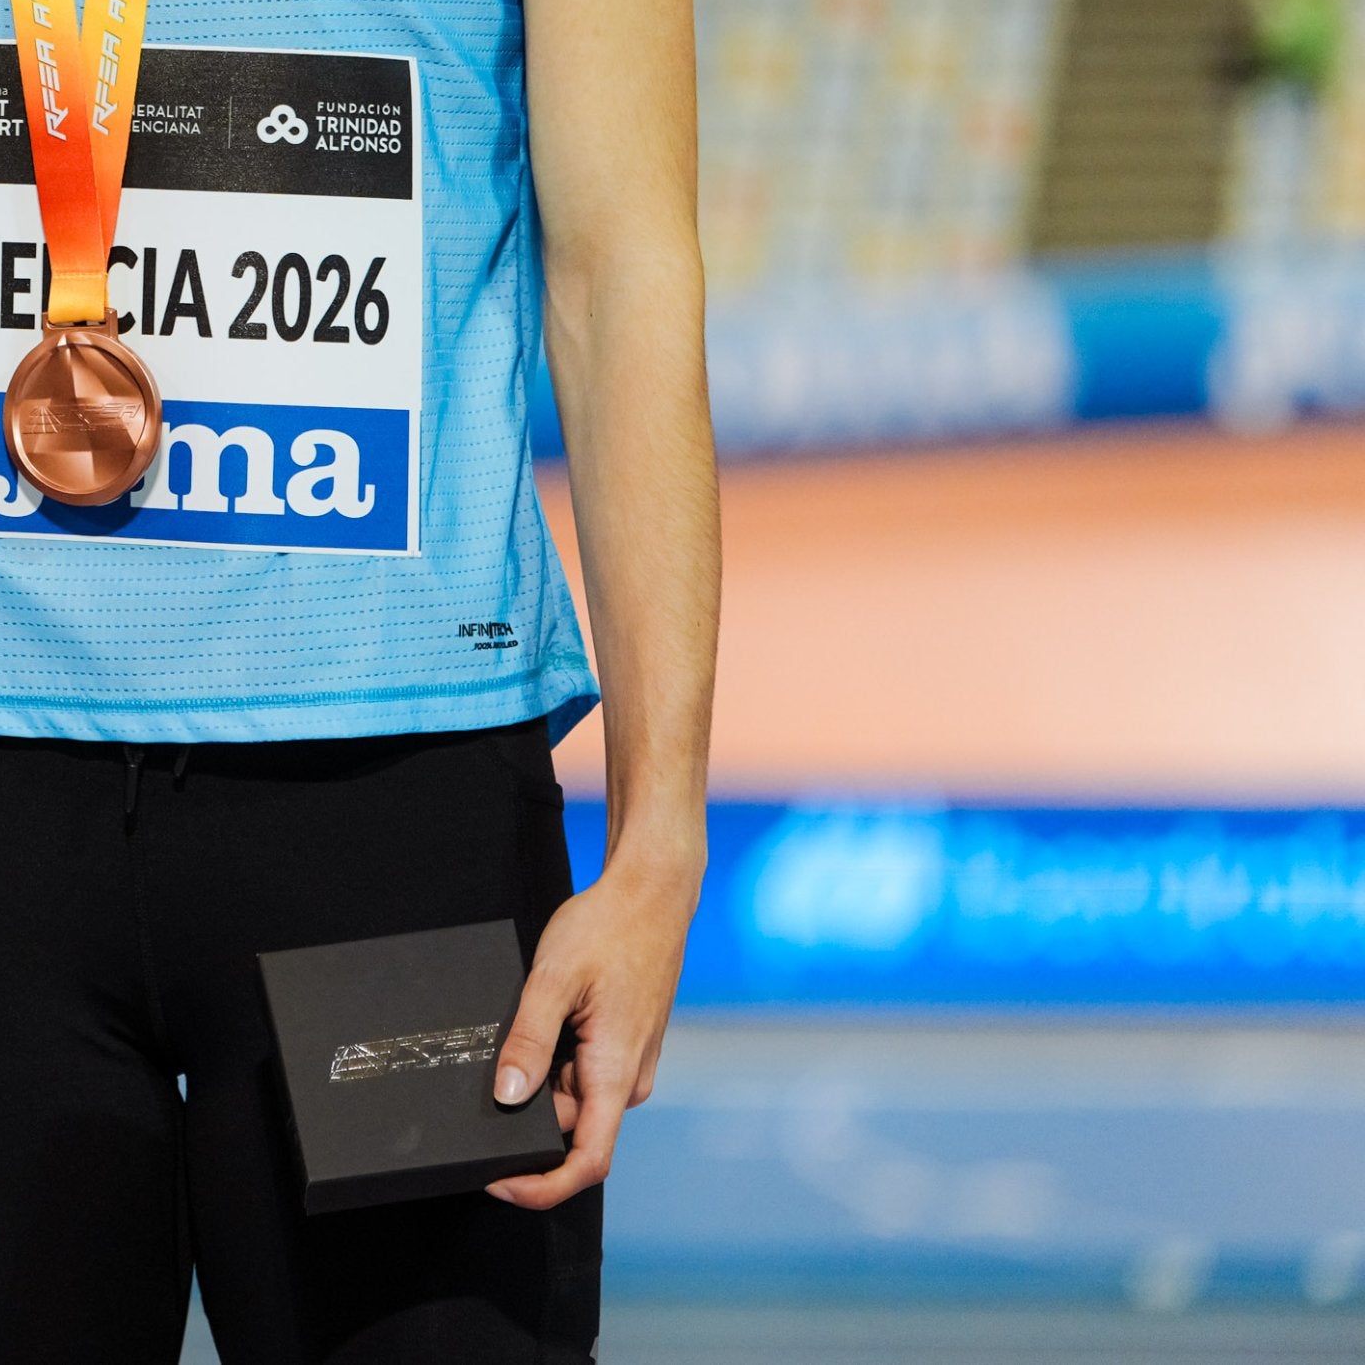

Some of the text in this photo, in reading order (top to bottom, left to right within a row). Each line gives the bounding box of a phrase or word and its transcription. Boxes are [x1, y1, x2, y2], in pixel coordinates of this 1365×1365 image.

[317, 101, 401, 116] FUNDACIÓN
[316, 116, 402, 136] TRINIDAD
[315, 135, 402, 154] ALFONSO
[228, 250, 390, 345] 2026
